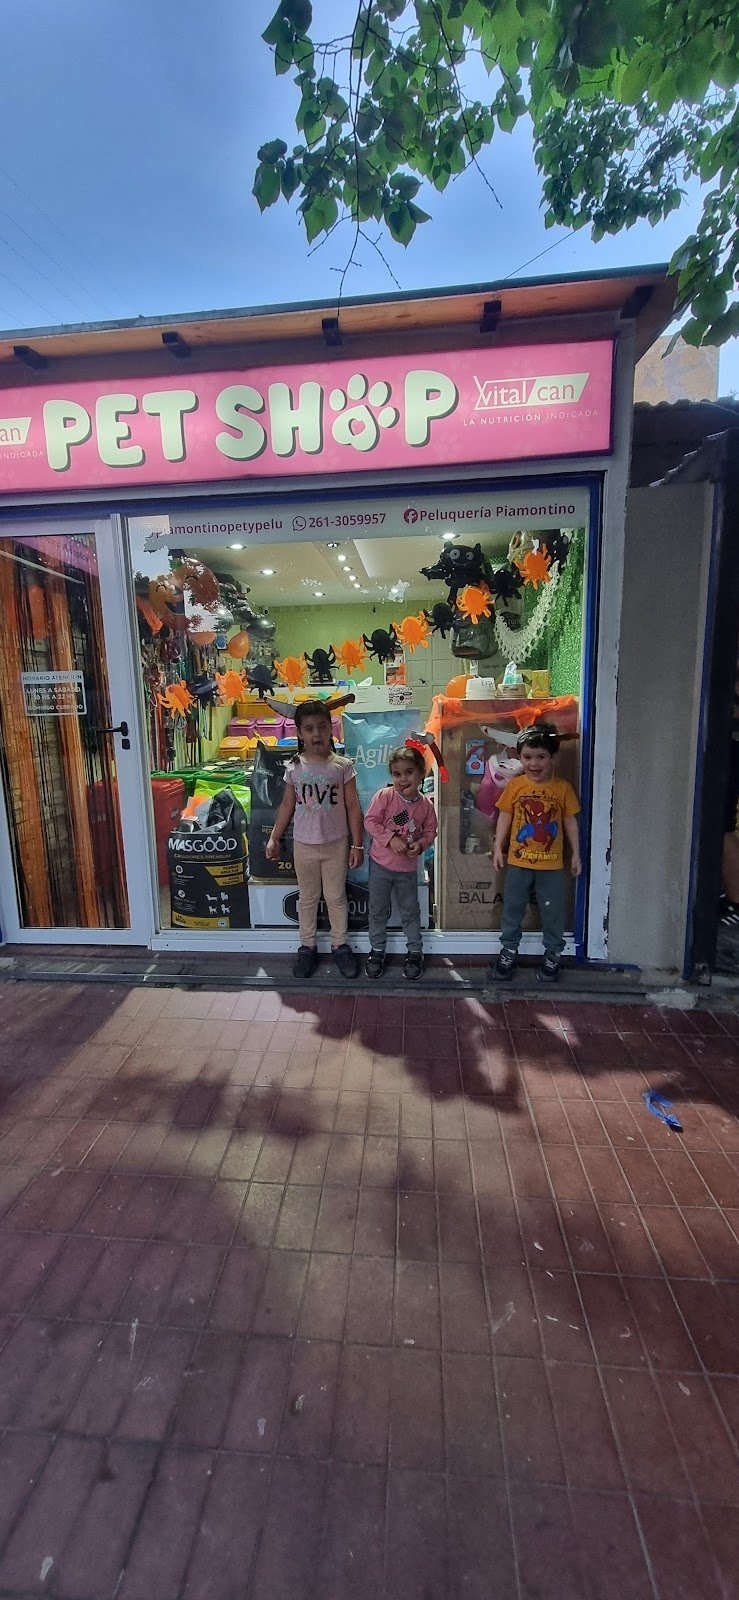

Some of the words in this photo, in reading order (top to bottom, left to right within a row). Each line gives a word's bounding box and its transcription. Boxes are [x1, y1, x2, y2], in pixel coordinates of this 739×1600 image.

[480, 411, 541, 425] NUTRICIÓN
[546, 409, 599, 420] INDICADA
[0, 427, 21, 442] an
[42, 390, 199, 472] PET
[156, 518, 283, 538] amontinopetypelu
[308, 512, 387, 529] 261-3059957
[420, 506, 491, 523] Peluquería
[496, 503, 576, 518] Piamontino
[278, 862, 292, 870] 20
